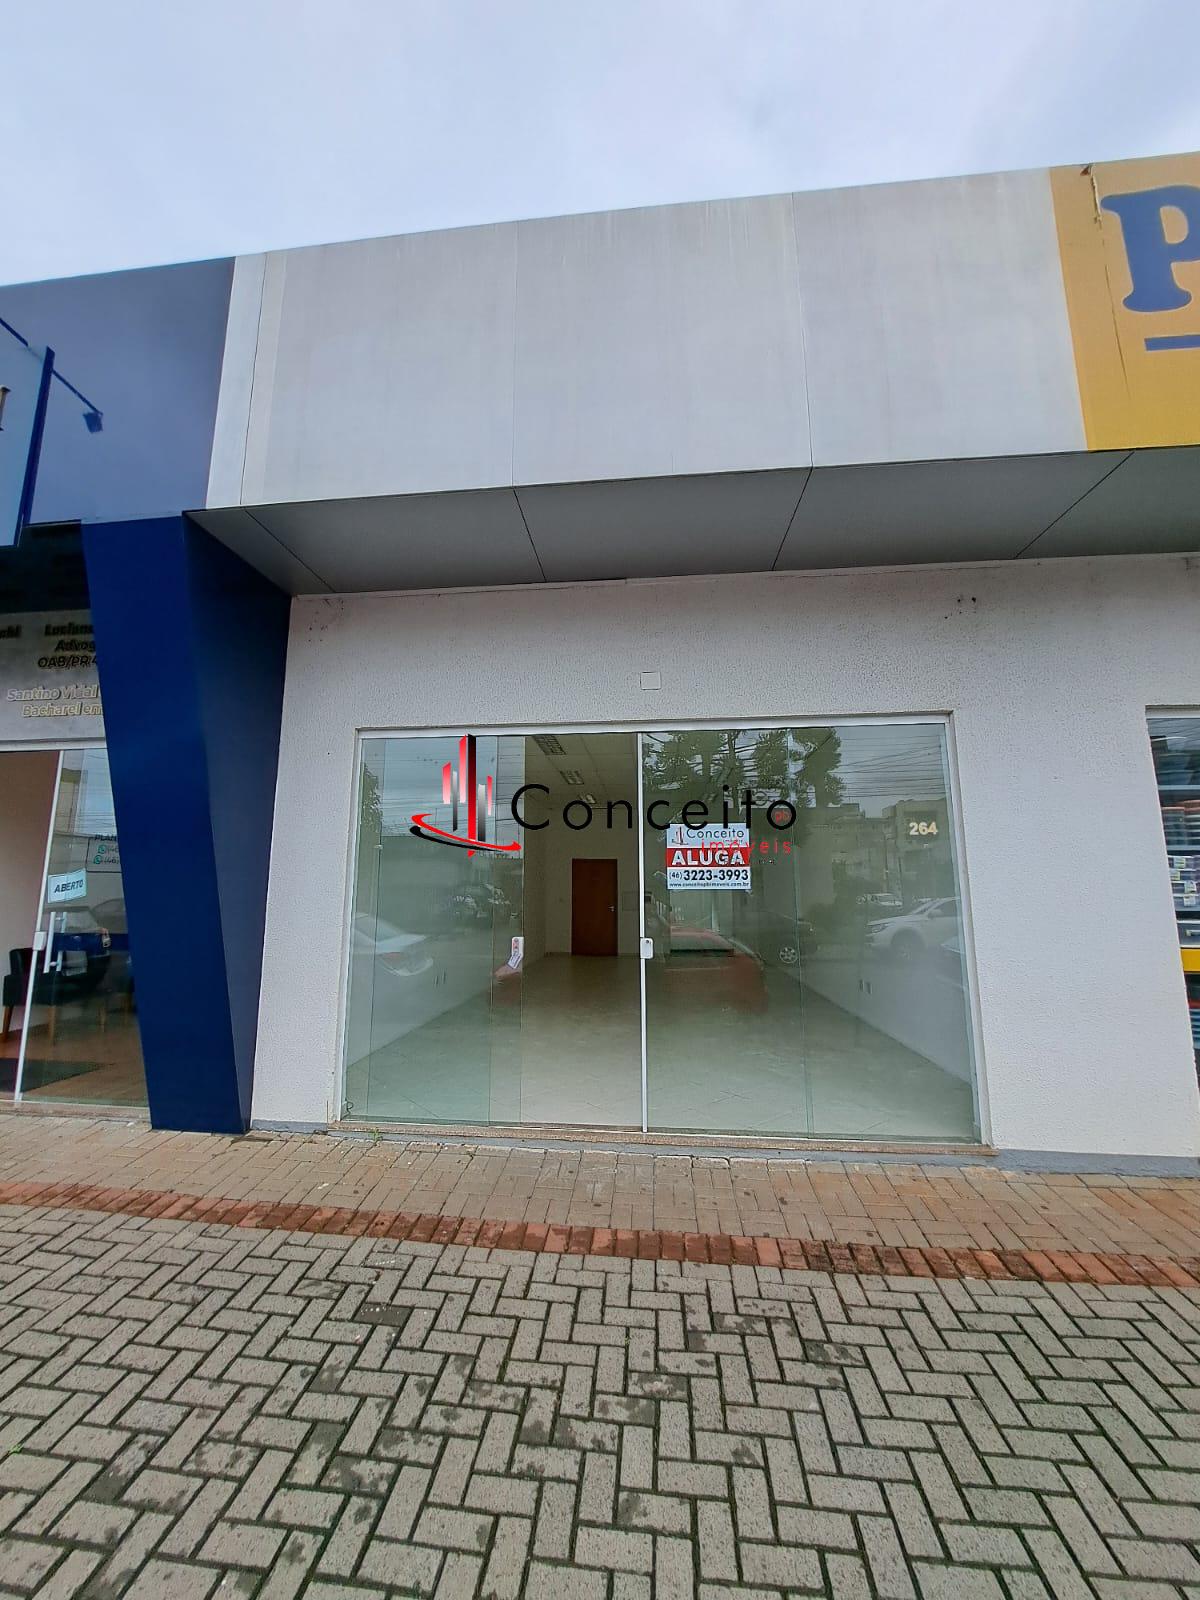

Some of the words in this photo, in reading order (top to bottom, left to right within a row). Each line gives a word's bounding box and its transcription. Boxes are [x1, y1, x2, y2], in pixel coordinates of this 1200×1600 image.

[8, 686, 61, 701] Santino
[62, 684, 98, 699] Vidal
[23, 702, 82, 717] Bacharel
[687, 827, 744, 839] Conceito
[909, 821, 938, 836] 264
[672, 849, 745, 866] ALUGA
[684, 869, 749, 881] 3223-3993
[54, 880, 84, 893] ABERTO
